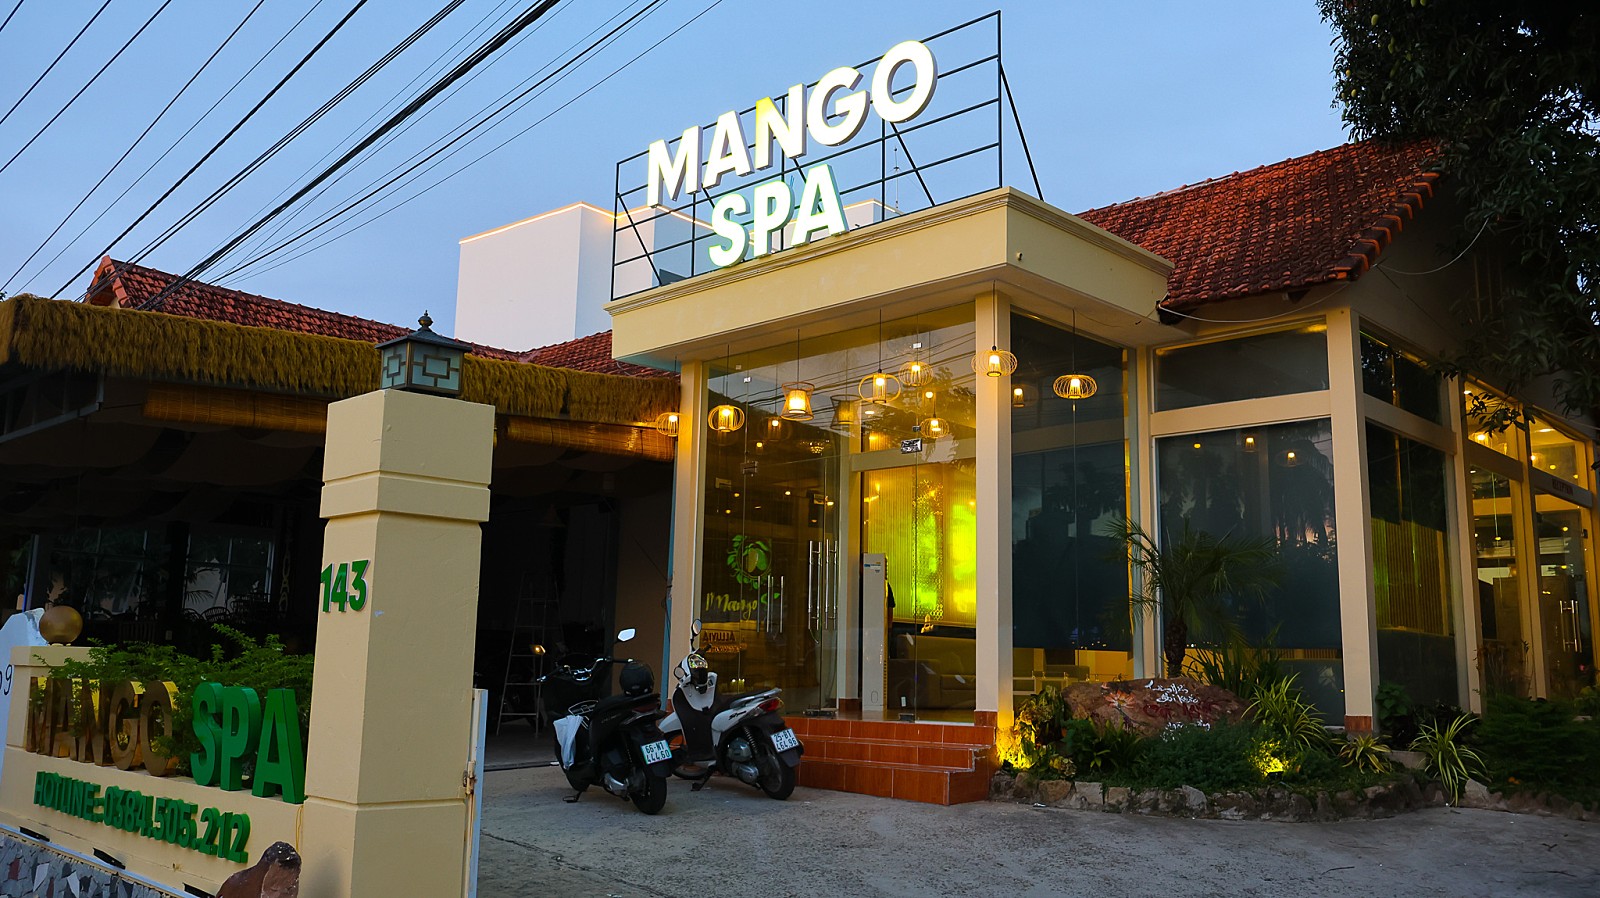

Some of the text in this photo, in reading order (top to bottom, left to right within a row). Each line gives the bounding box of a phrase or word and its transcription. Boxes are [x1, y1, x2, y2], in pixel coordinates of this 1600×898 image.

[647, 40, 938, 208] MANGO
[708, 163, 850, 269] SPA
[320, 559, 370, 613] 143
[190, 681, 307, 805] SPA
